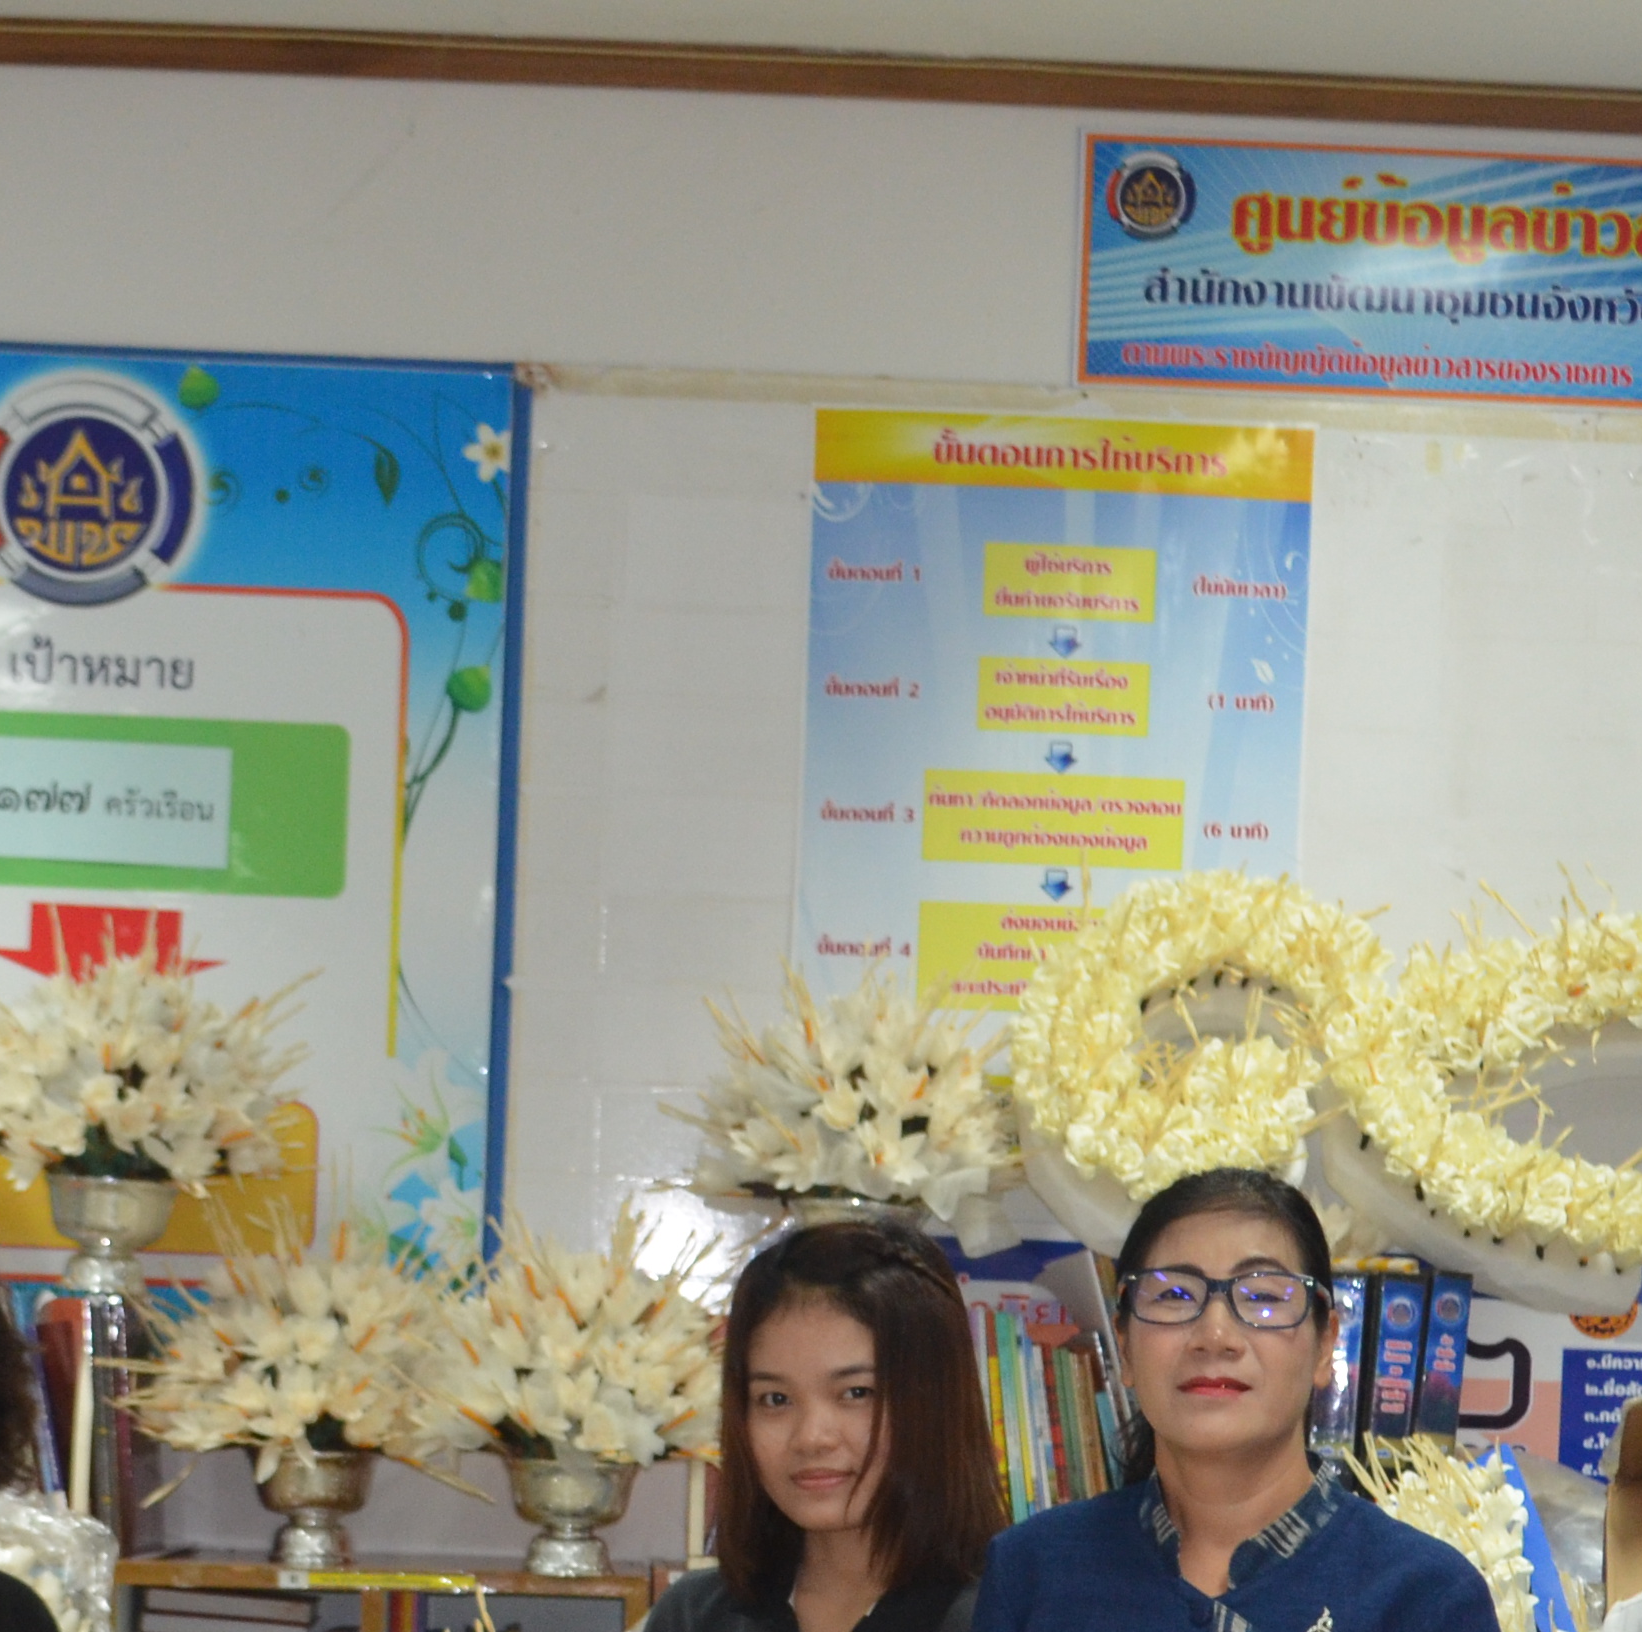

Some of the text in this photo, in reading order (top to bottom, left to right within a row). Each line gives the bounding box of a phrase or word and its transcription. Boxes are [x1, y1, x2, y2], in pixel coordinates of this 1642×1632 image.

[932, 428, 1228, 478] ขั้นตอนการให้บริการ
[912, 564, 921, 583] 1
[8, 632, 195, 692] เป้าหมาย
[908, 682, 920, 699] 2
[104, 785, 215, 824] ครัวเรือน
[903, 806, 915, 823] 3
[899, 942, 912, 958] 4
